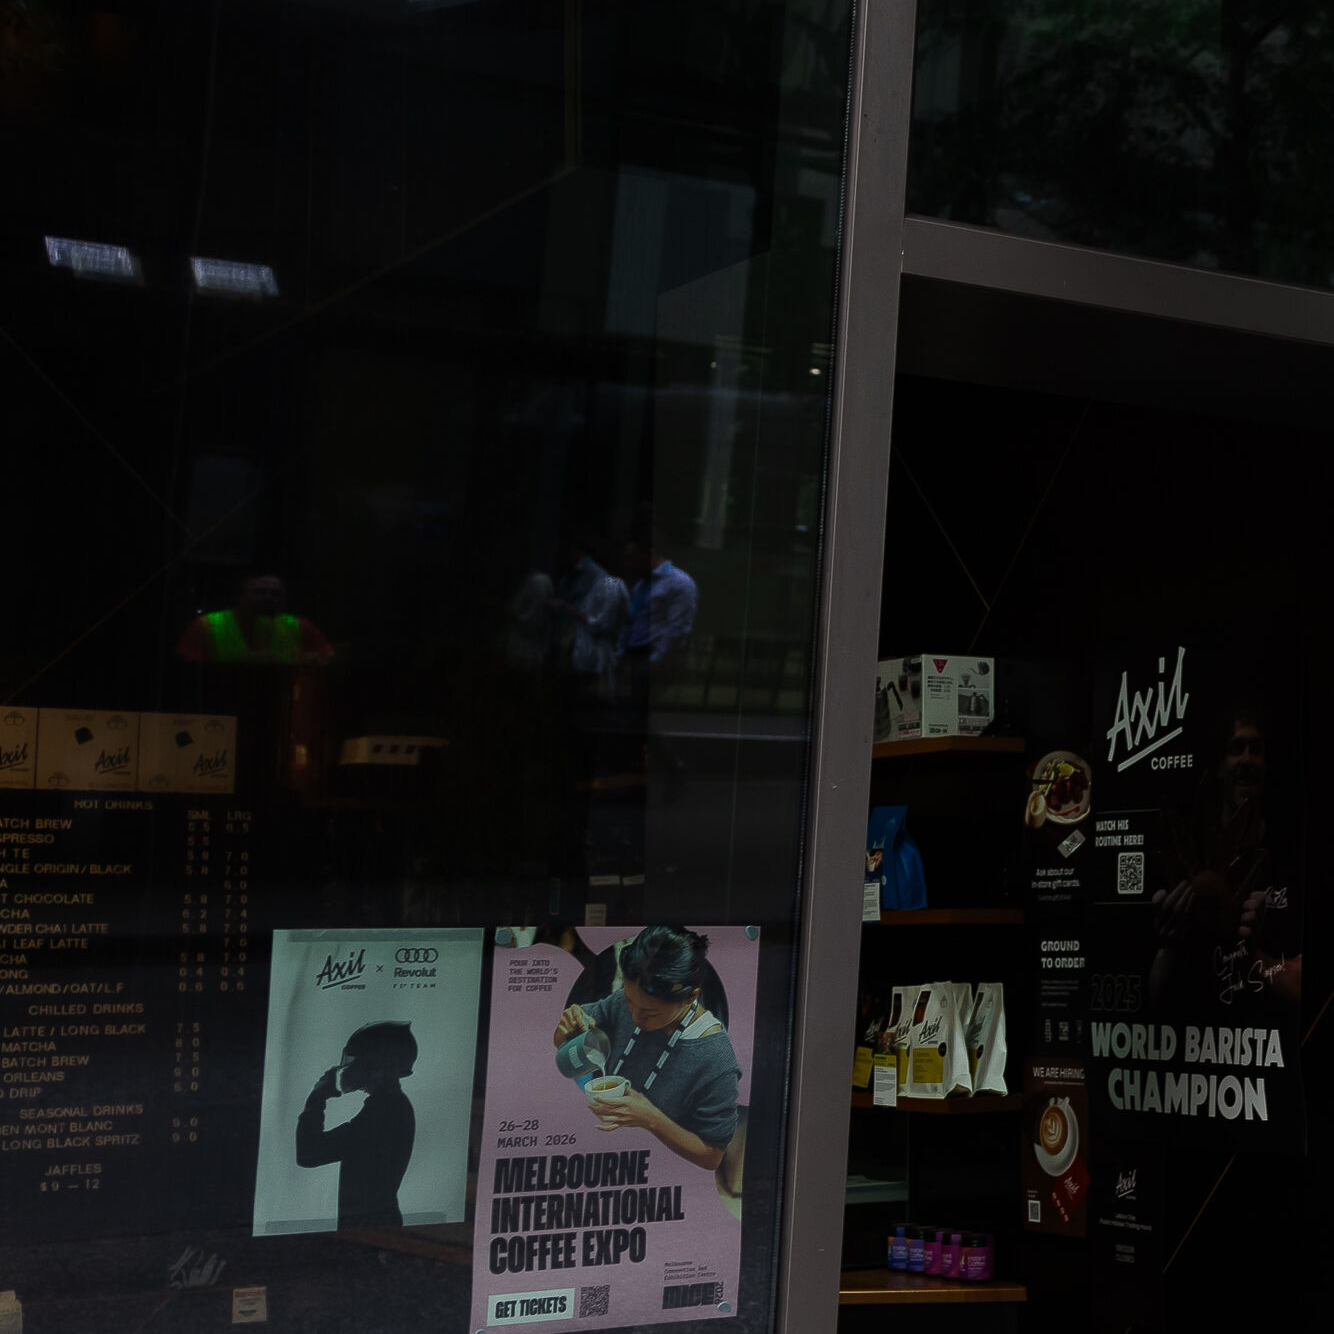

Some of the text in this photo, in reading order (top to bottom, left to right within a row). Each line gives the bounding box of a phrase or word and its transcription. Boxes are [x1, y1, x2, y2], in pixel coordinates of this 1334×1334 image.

[1106, 644, 1190, 762] Axil
[1150, 754, 1194, 771] COFFEE
[73, 799, 153, 811] HOT DRINKS
[35, 818, 73, 830] BREW
[1117, 819, 1130, 831] HIS
[14, 893, 95, 905] CHOCOLATE
[35, 923, 67, 934] CHAI
[72, 923, 110, 934] LATTE
[13, 938, 46, 949] LEAF
[50, 938, 89, 949] LATTE
[1040, 940, 1081, 952] GROUND
[316, 949, 367, 986] Axil
[531, 959, 551, 967] INTO
[1040, 956, 1087, 969] TO ORDER
[394, 967, 437, 978] Revolut
[508, 976, 558, 984] DESTINATION
[525, 984, 553, 992] COFFEE
[1090, 972, 1143, 1013] 2025
[28, 1003, 145, 1016] CHILLED DRINKS
[3, 1026, 46, 1038] LATTE
[60, 1025, 100, 1037] LONG
[104, 1024, 147, 1035] BLACK
[2, 1041, 57, 1052] MATCHA
[1090, 1020, 1178, 1062] WORLD
[1184, 1024, 1286, 1069] BARISTA
[1, 1056, 46, 1068] BATCH
[51, 1055, 90, 1067] BREW
[3, 1071, 65, 1083] ORLEANS
[1032, 1066, 1045, 1078] WE
[1046, 1067, 1060, 1078] ARE
[9, 1087, 43, 1099] DRIP
[1107, 1066, 1270, 1122] CHAMPION
[19, 1104, 144, 1119] SEASONAL DRINKS
[24, 1123, 65, 1135] MONT
[69, 1121, 113, 1132] BLANC
[2, 1140, 42, 1152] LONG
[46, 1137, 91, 1149] BLACK
[95, 1134, 140, 1146] SPRITZ
[497, 1133, 577, 1149] MARCH 2026
[44, 1163, 102, 1177] JAFFLES
[493, 1149, 651, 1195] MELBOURNE
[490, 1185, 685, 1235] INTERNATIONAL
[489, 1226, 647, 1275] COFFEE EXPO
[495, 1295, 568, 1320] GET TICKETS
